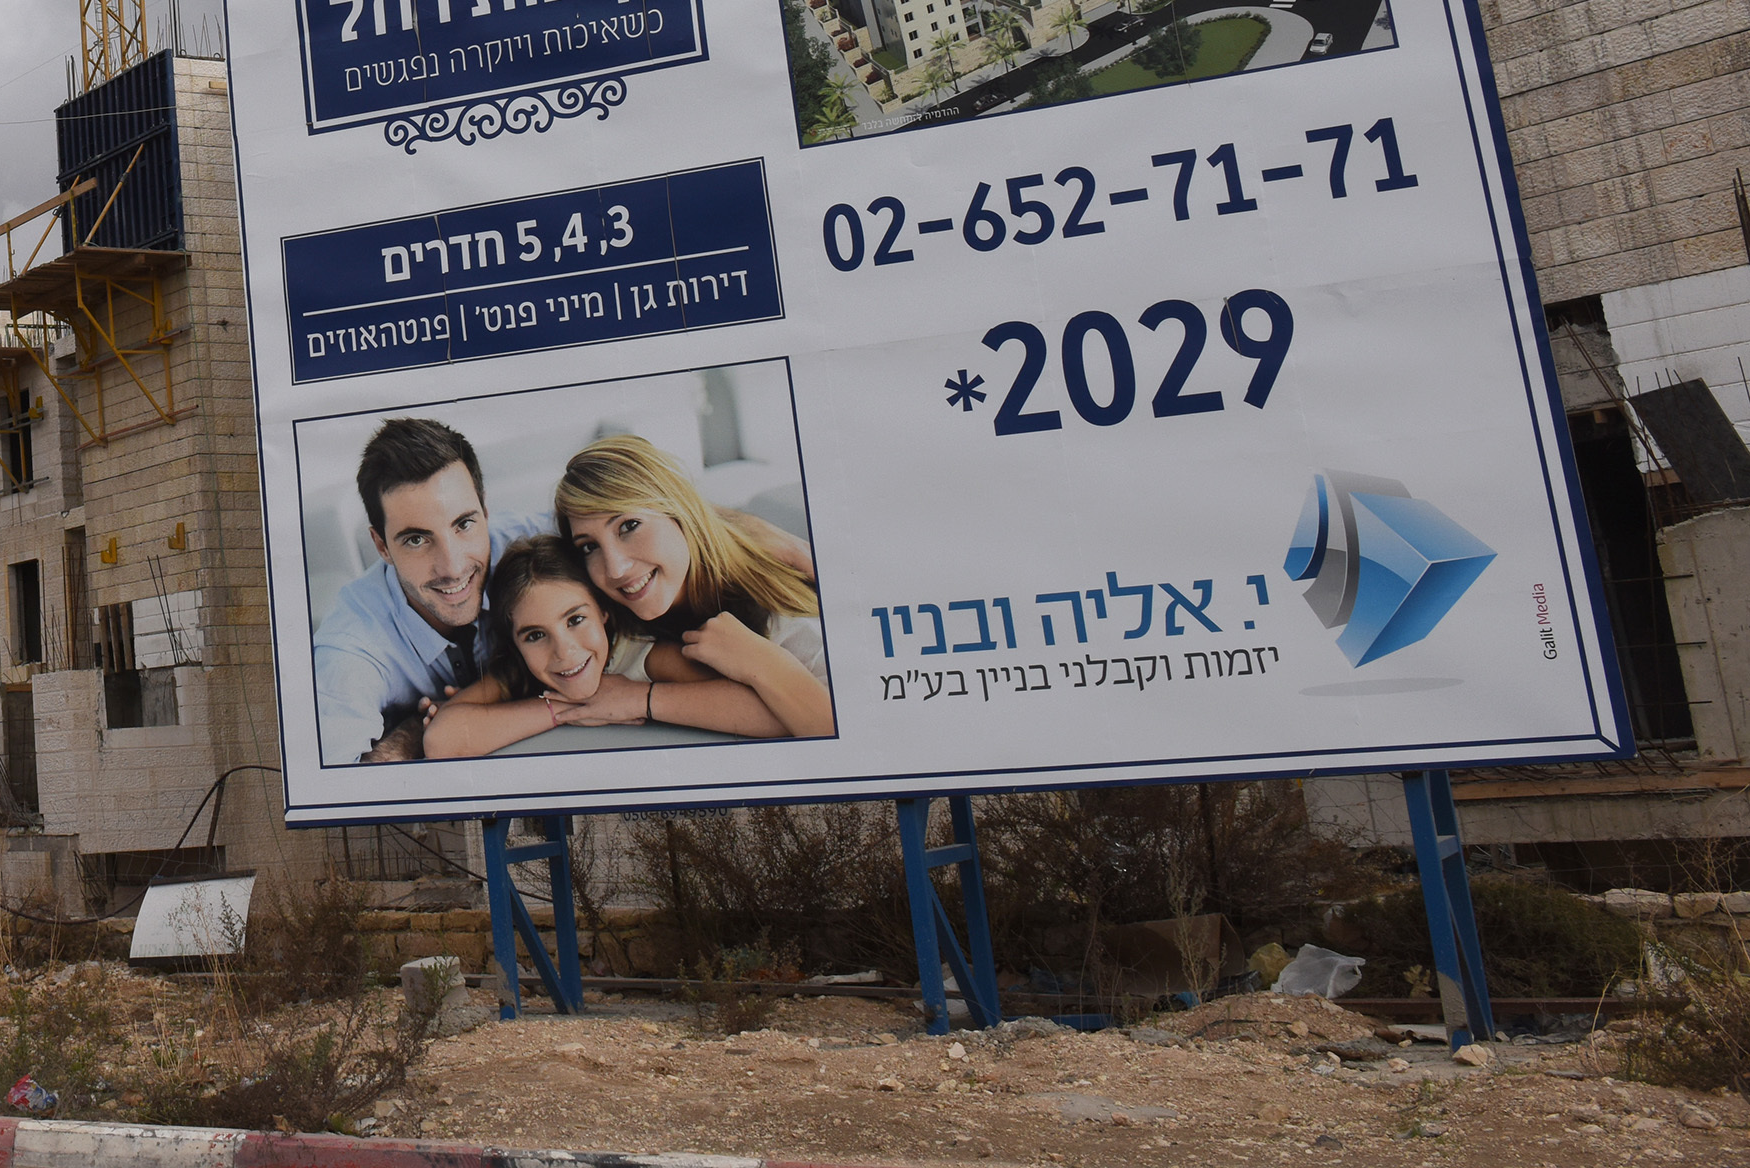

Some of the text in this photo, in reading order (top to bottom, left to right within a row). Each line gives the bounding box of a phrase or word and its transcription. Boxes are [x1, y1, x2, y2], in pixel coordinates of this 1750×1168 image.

[344, 8, 664, 92] כשאיכות ויוקרה נפגשים
[862, 120, 883, 130] בלבד
[925, 106, 960, 119] ההדמיה
[822, 117, 1419, 272] 02-652-71-71
[382, 229, 506, 283] חדרים
[307, 270, 748, 358] דירות גן מיני פנט' פנטהאוזים
[872, 597, 1017, 658] ובניו
[1035, 571, 1223, 646] אליה
[1532, 583, 1558, 660] Galit Media
[880, 646, 1279, 702] יזמות וקבלני בניין בע"מ
